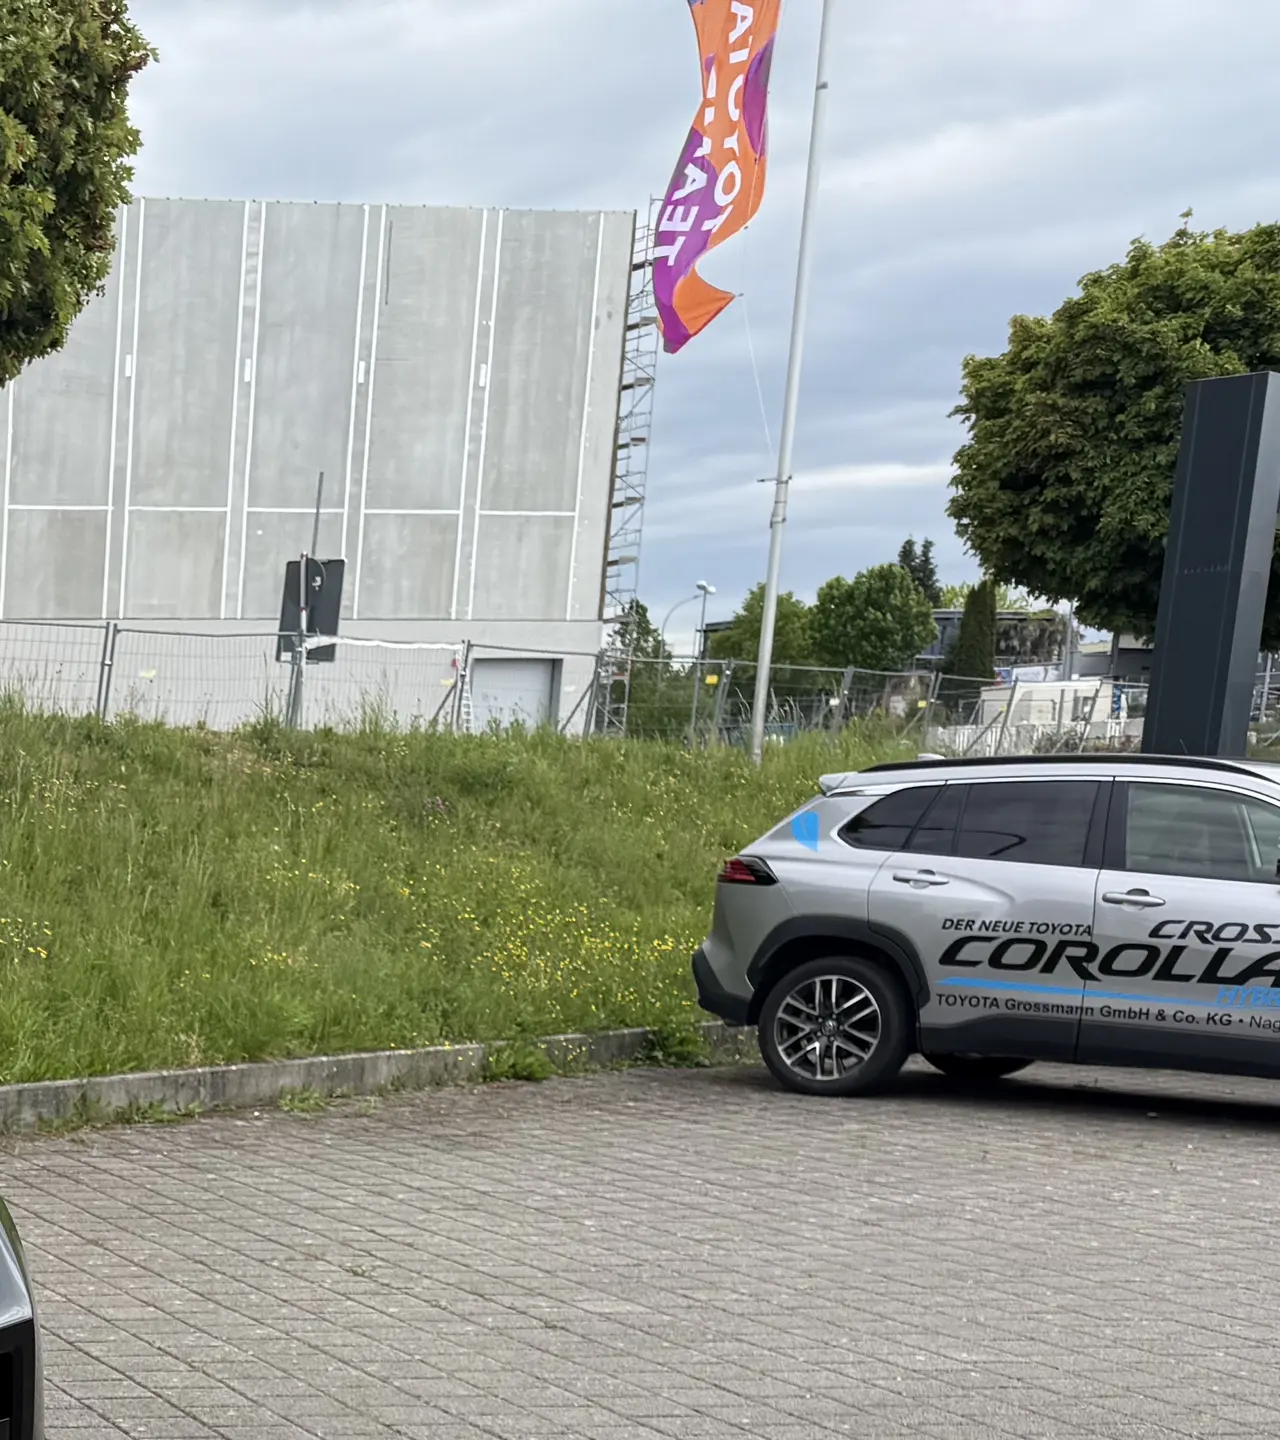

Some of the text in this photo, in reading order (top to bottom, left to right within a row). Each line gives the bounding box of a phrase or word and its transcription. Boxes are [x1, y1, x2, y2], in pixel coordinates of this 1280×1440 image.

[941, 918, 1092, 936] DER NEUE TOYOTA
[1148, 920, 1280, 945] CROS
[936, 993, 1000, 1009] TOYOTA
[1005, 998, 1094, 1016] Grossmann
[1100, 1005, 1149, 1021] GmbH
[1155, 1009, 1166, 1022] &
[1173, 1010, 1200, 1024] Co.
[1206, 1012, 1232, 1026] KG
